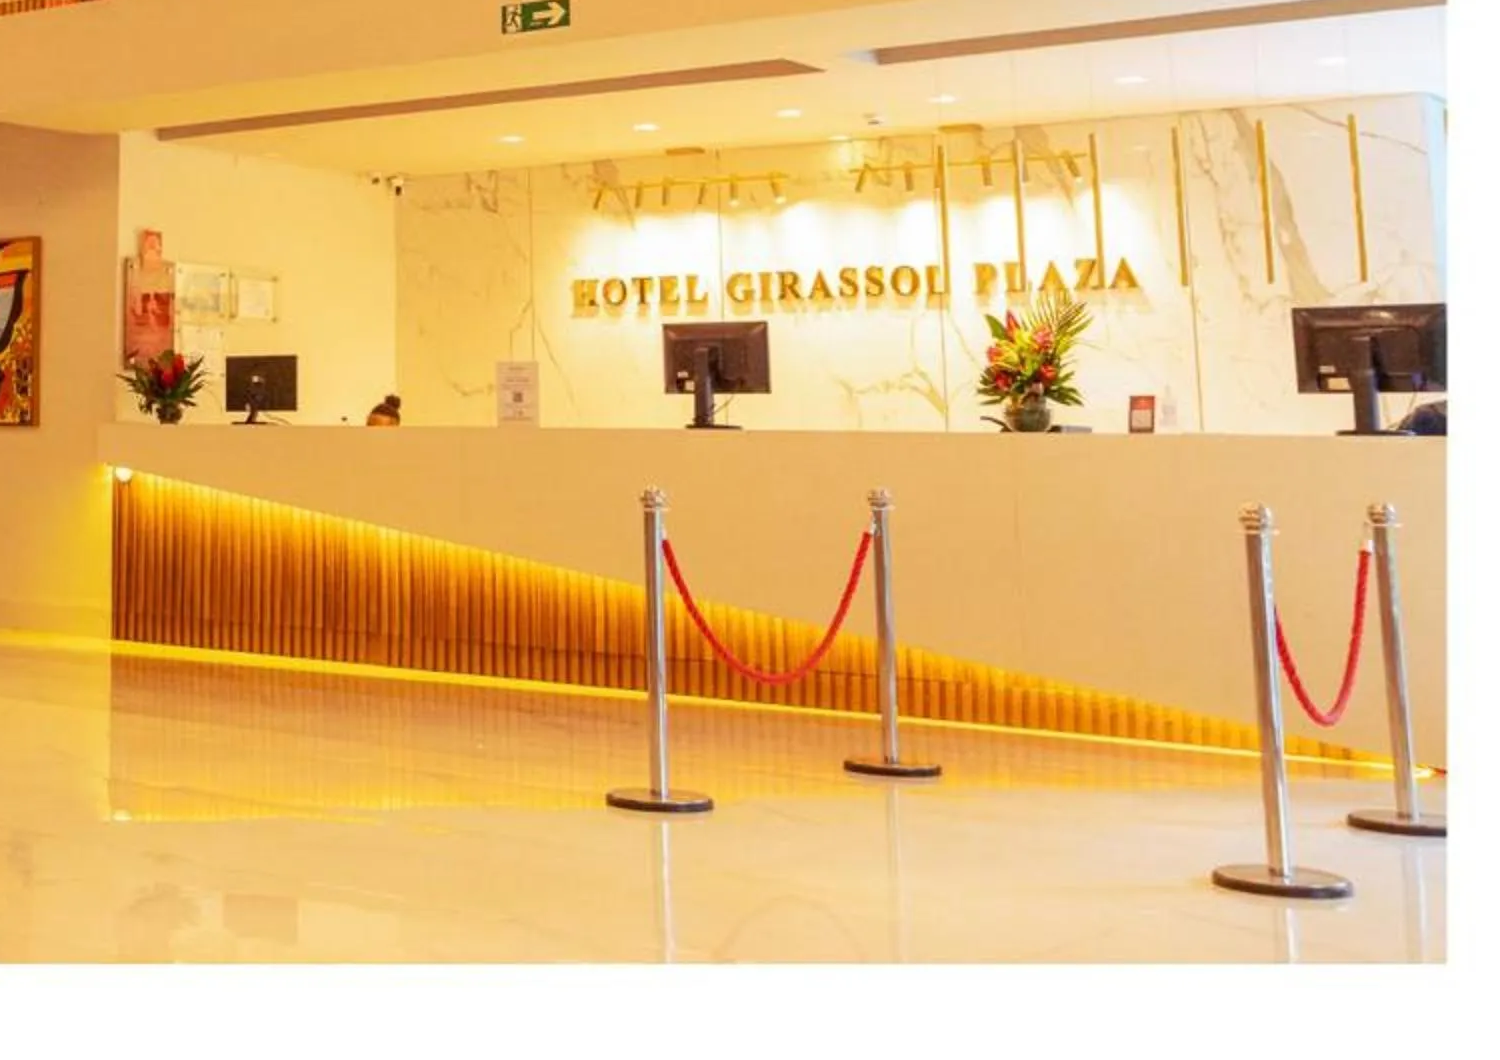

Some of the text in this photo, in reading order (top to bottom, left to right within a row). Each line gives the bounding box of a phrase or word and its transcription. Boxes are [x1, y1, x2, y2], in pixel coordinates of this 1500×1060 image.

[571, 257, 1140, 307] HOTEL GIRASSOL PLAZA
